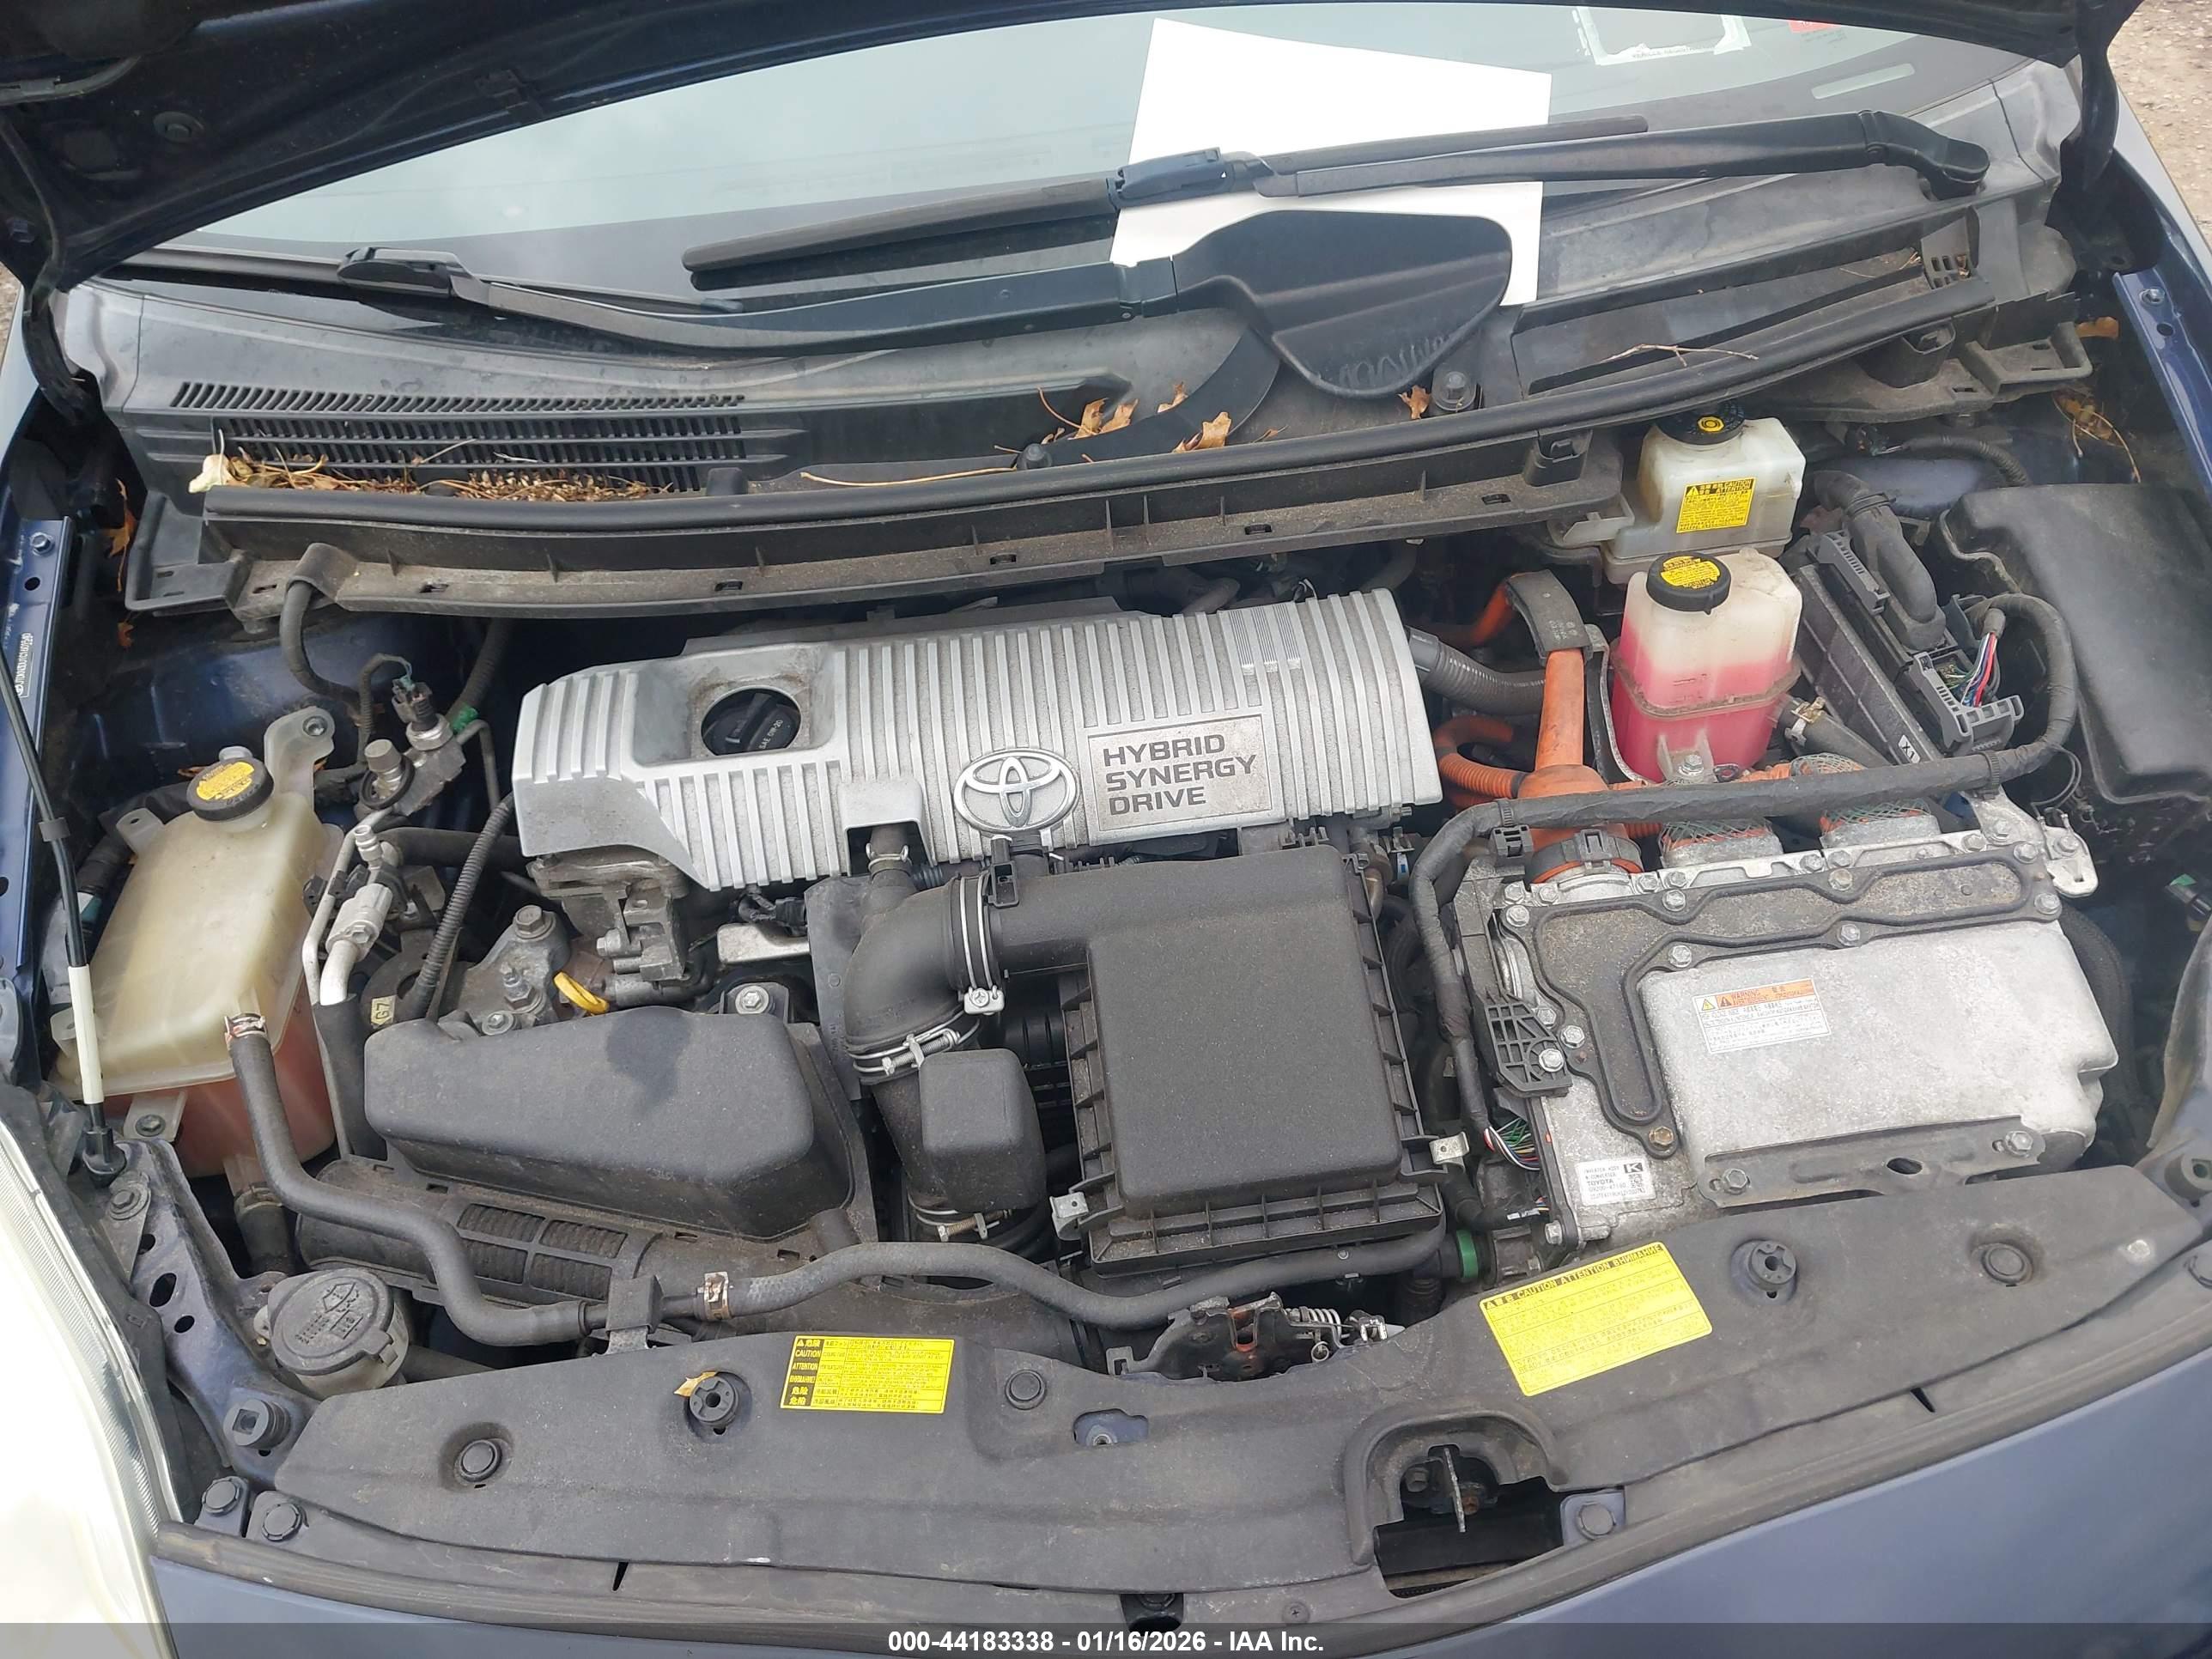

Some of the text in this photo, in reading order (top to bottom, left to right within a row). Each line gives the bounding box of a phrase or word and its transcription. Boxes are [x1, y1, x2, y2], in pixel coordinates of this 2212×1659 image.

[1103, 734, 1225, 767] HYBRID
[1106, 754, 1257, 792] SYNERGY
[1109, 786, 1206, 816] DRIVE
[1517, 1279, 1558, 1298] CAUTION
[1560, 1261, 1610, 1285] ATTENTION
[792, 1362, 818, 1371] ATTENTION
[794, 1349, 821, 1358] CAUTION
